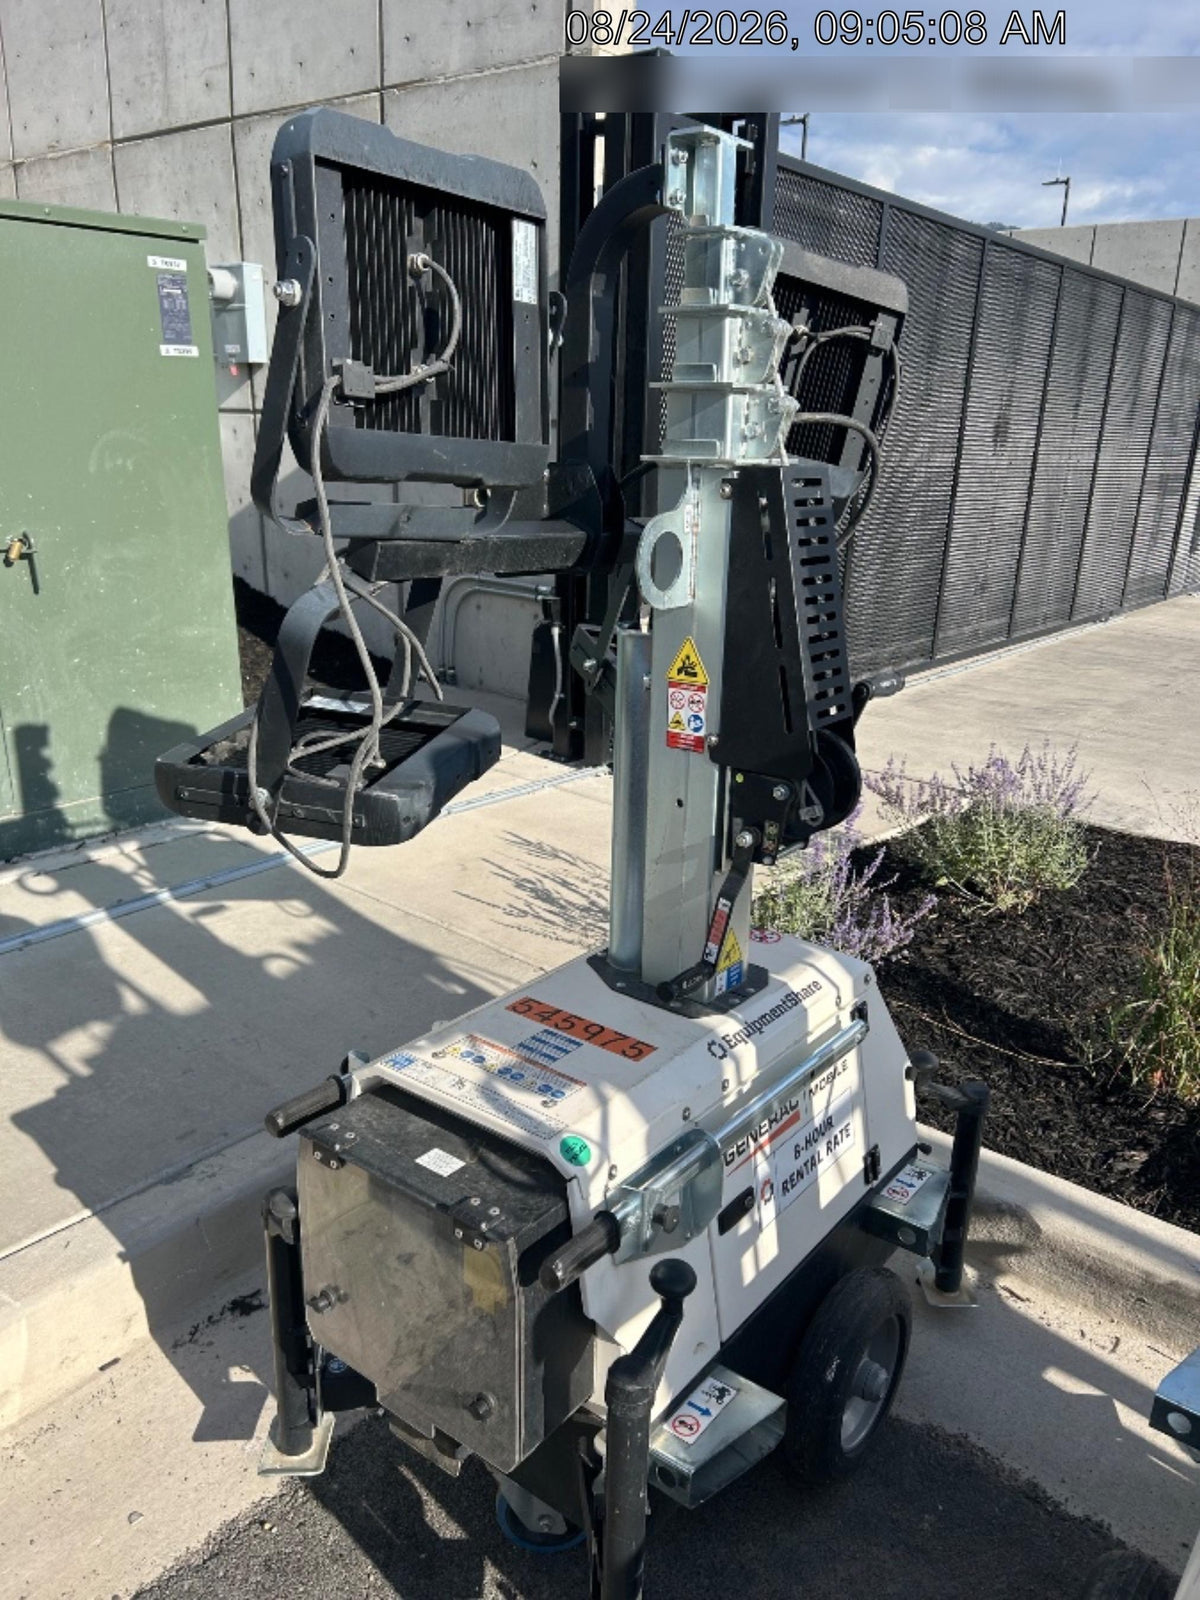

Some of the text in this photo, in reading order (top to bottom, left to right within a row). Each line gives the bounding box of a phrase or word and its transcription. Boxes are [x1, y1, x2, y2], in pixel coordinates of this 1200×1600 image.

[512, 998, 658, 1061] 545975
[721, 978, 823, 1050] EquipmentShare
[781, 1122, 851, 1196] RENTAL RATE
